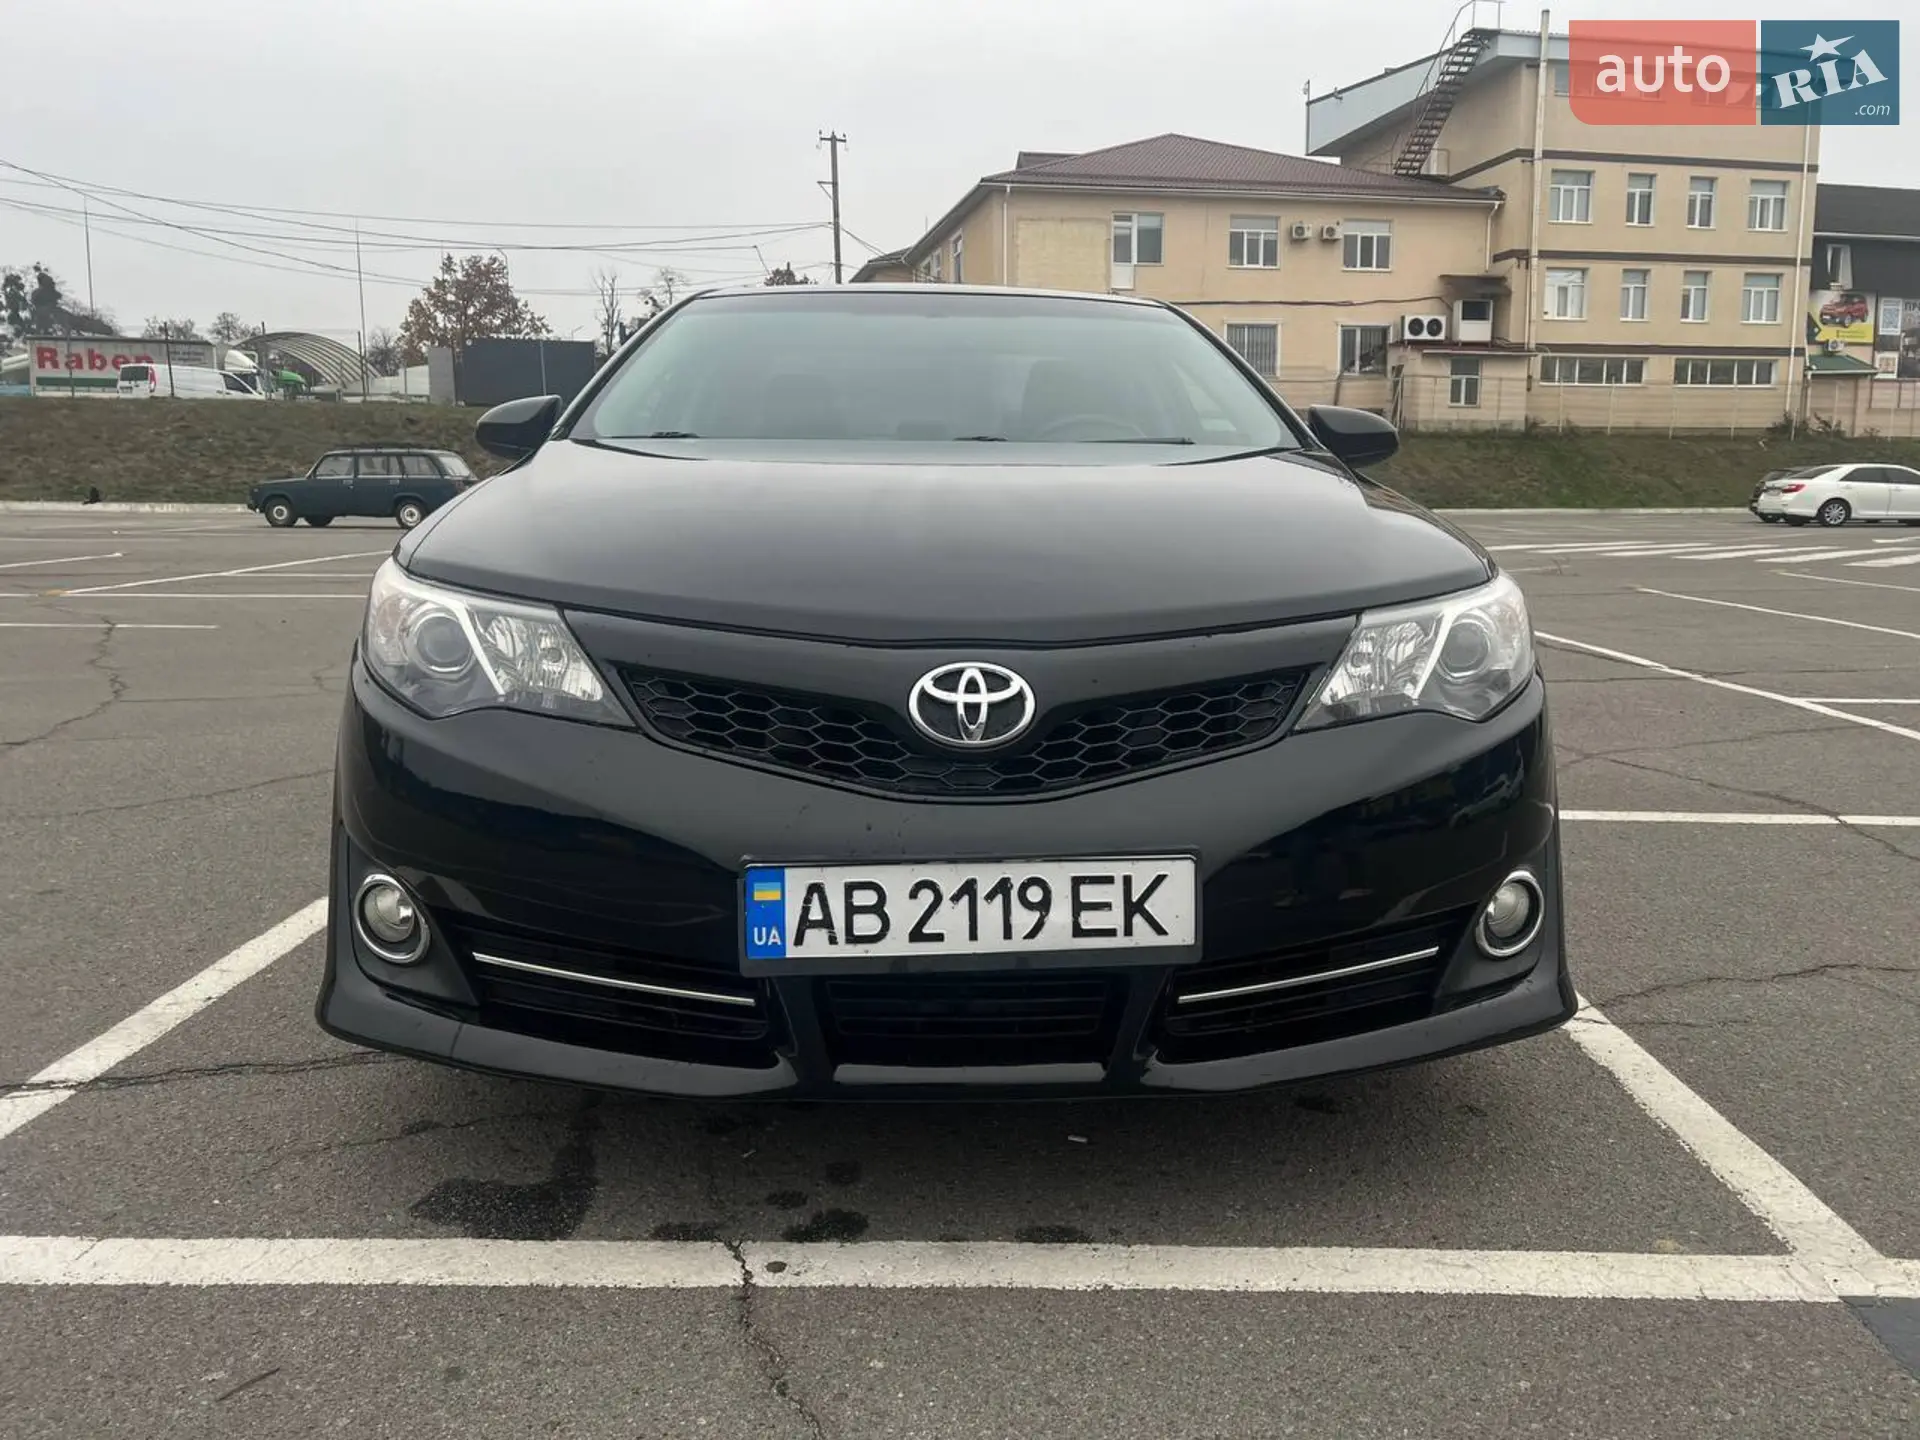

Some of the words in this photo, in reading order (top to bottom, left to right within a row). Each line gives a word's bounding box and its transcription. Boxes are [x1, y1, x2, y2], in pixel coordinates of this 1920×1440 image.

[793, 879, 890, 946] AB
[908, 876, 1052, 943] 2119
[1070, 873, 1169, 938] EK
[753, 926, 781, 946] UA
